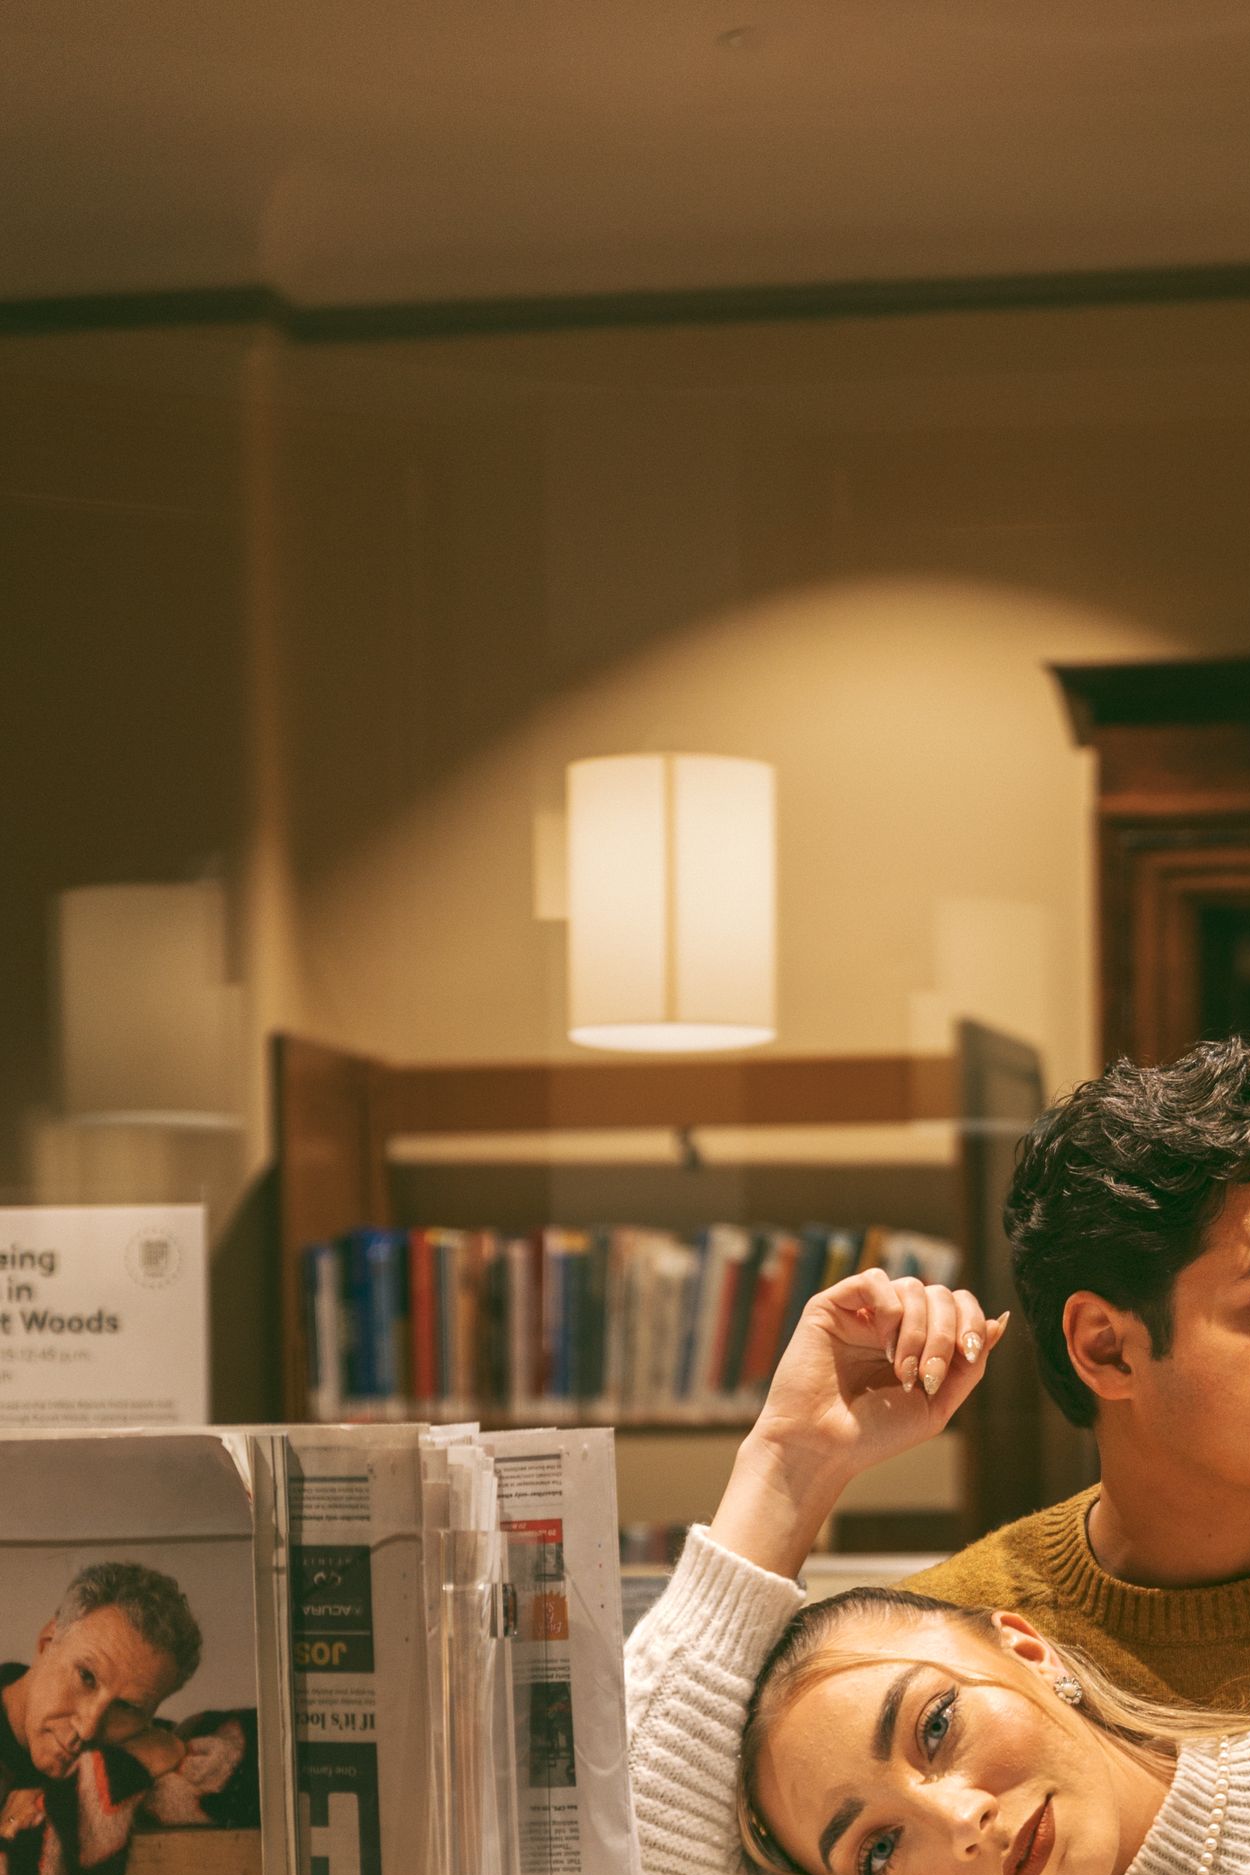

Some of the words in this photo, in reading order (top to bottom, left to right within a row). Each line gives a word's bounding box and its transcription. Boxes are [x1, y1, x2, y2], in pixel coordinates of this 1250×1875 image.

[7, 1277, 33, 1301] in
[20, 1307, 119, 1335] Woods
[302, 1606, 352, 1616] ACURA
[361, 1712, 376, 1731] If
